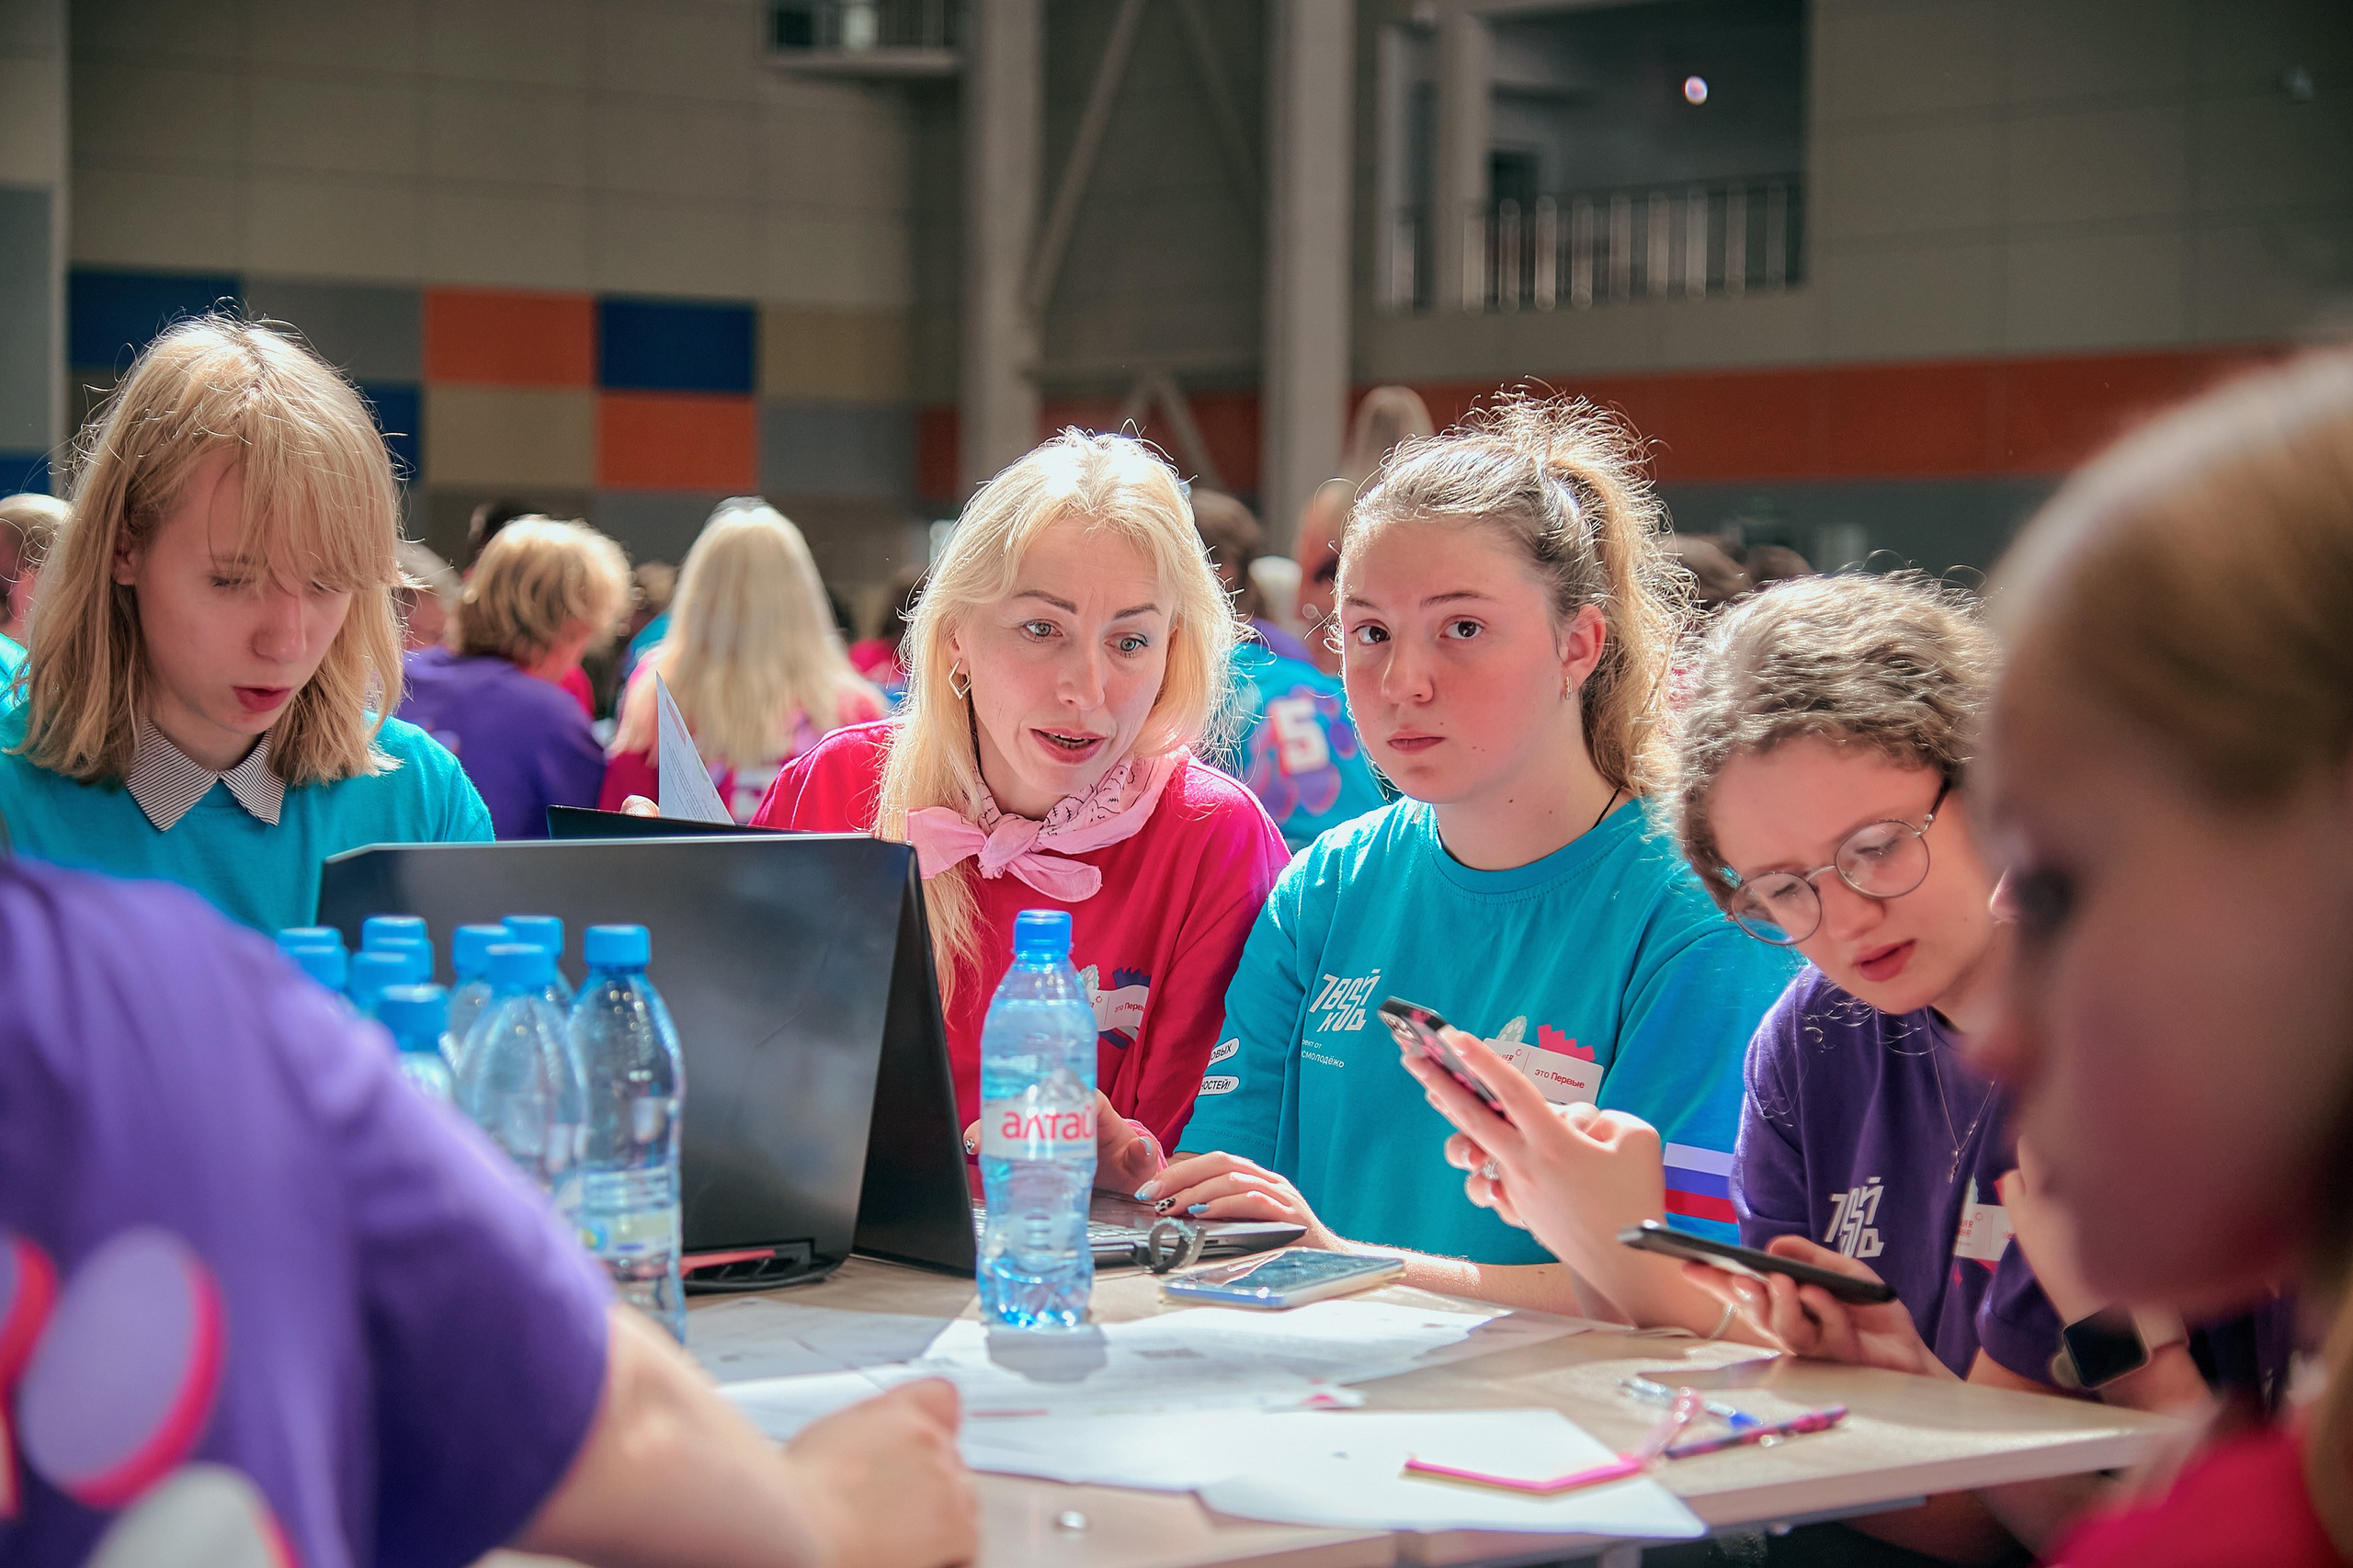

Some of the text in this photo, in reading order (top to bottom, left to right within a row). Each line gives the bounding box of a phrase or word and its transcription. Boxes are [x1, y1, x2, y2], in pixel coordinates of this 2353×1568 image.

[1202, 1079, 1231, 1090] ОСТЕЙ!
[1535, 1069, 1586, 1088] это Первые
